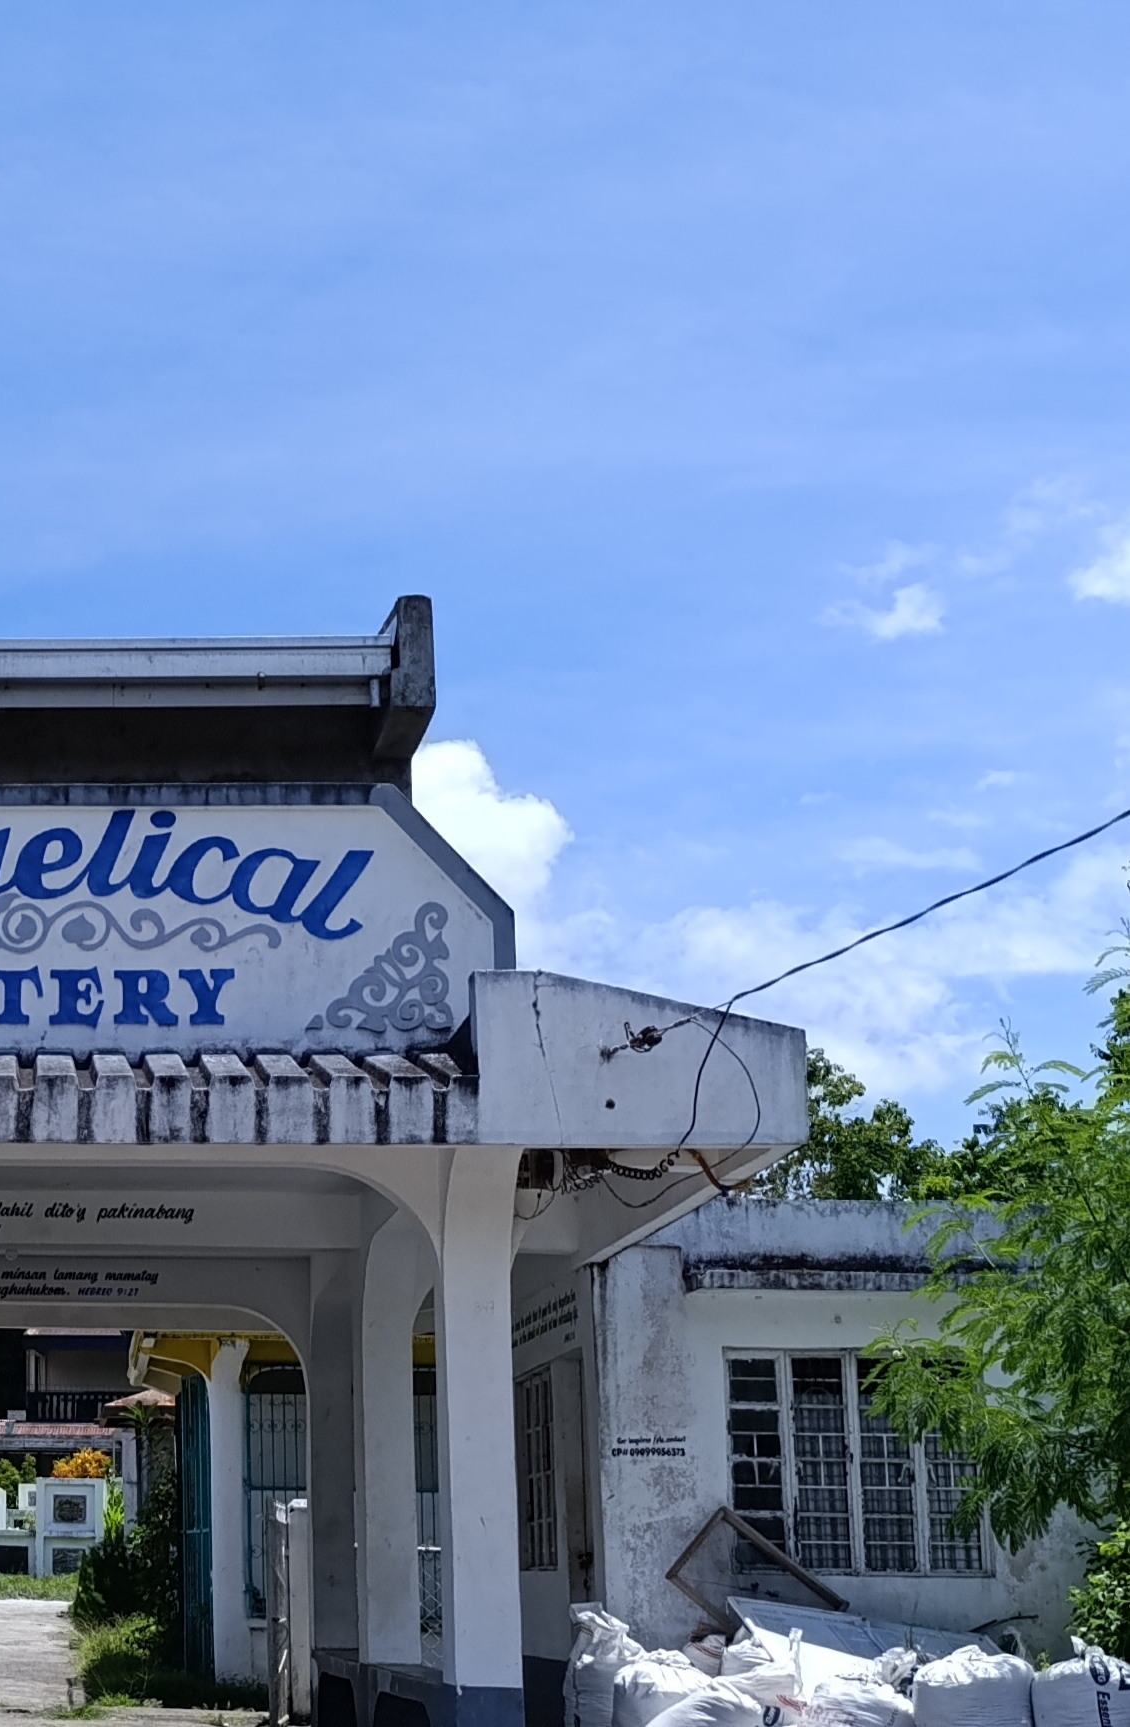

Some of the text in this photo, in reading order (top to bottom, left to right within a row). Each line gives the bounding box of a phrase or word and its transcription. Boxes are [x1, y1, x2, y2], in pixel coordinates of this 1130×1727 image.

[96, 1202, 195, 1224] pakinabang
[0, 1267, 47, 1281] minsan
[53, 1268, 99, 1284] lamang
[104, 1269, 160, 1285] mamatay
[77, 1286, 113, 1297] HEBREO
